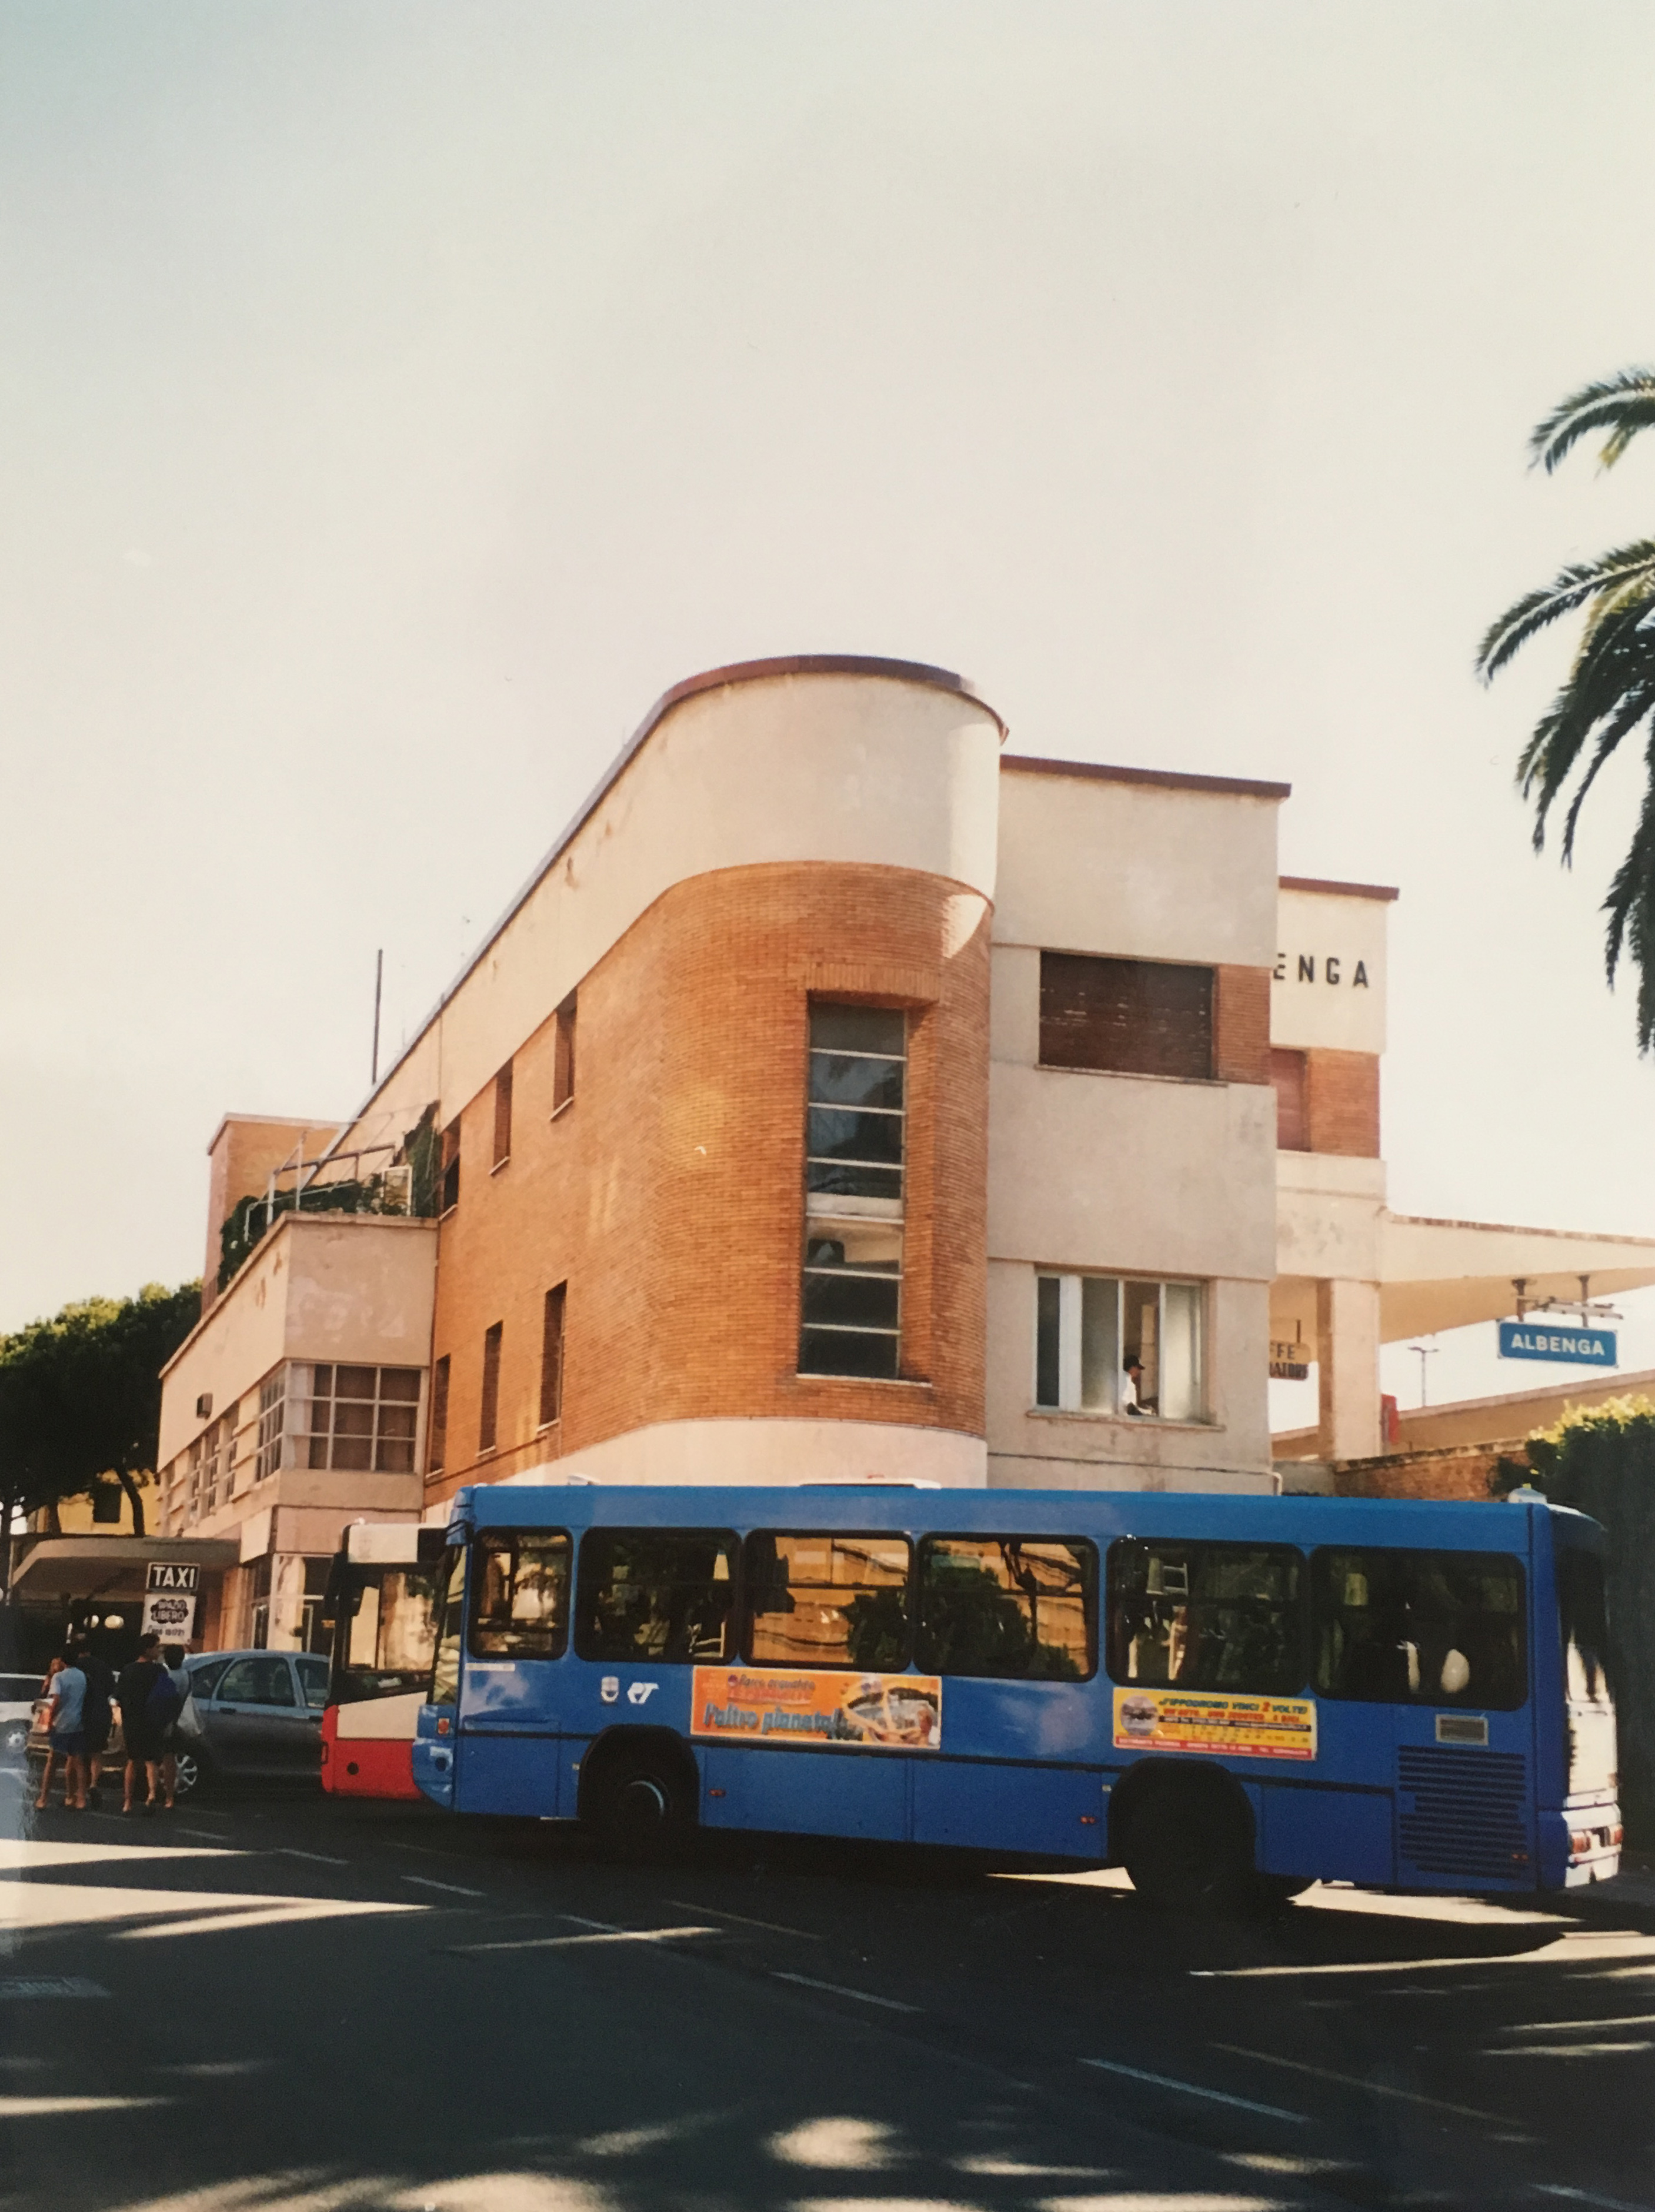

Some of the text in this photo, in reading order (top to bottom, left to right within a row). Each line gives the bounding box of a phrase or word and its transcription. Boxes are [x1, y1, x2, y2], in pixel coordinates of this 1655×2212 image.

[1273, 953, 1369, 988] ENGA
[1511, 1332, 1606, 1356] ALBENGA
[153, 1566, 195, 1588] TAXI
[152, 1610, 185, 1620] LIBERO
[1262, 1701, 1270, 1712] 2
